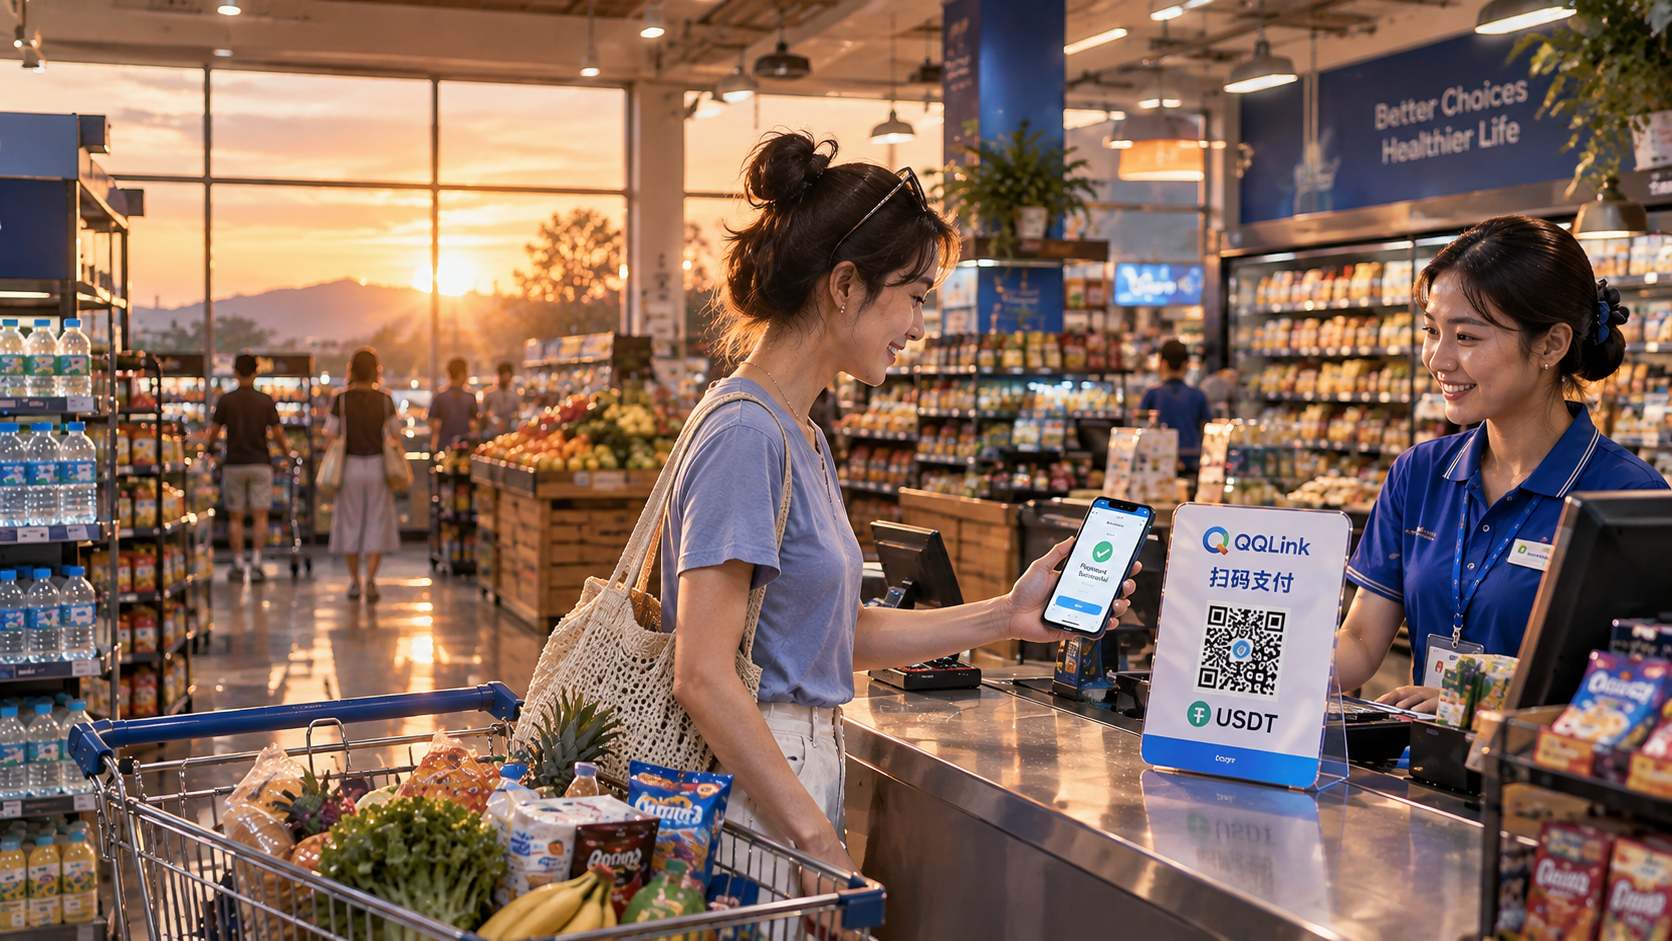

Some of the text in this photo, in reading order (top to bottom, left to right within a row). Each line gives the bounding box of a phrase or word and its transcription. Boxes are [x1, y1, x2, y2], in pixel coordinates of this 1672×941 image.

[1374, 79, 1529, 131] Better Choices
[1381, 114, 1521, 165] Healthier Life
[1234, 533, 1311, 556] QQLink
[1209, 566, 1294, 593] 扫码支付
[1216, 707, 1279, 733] USDT
